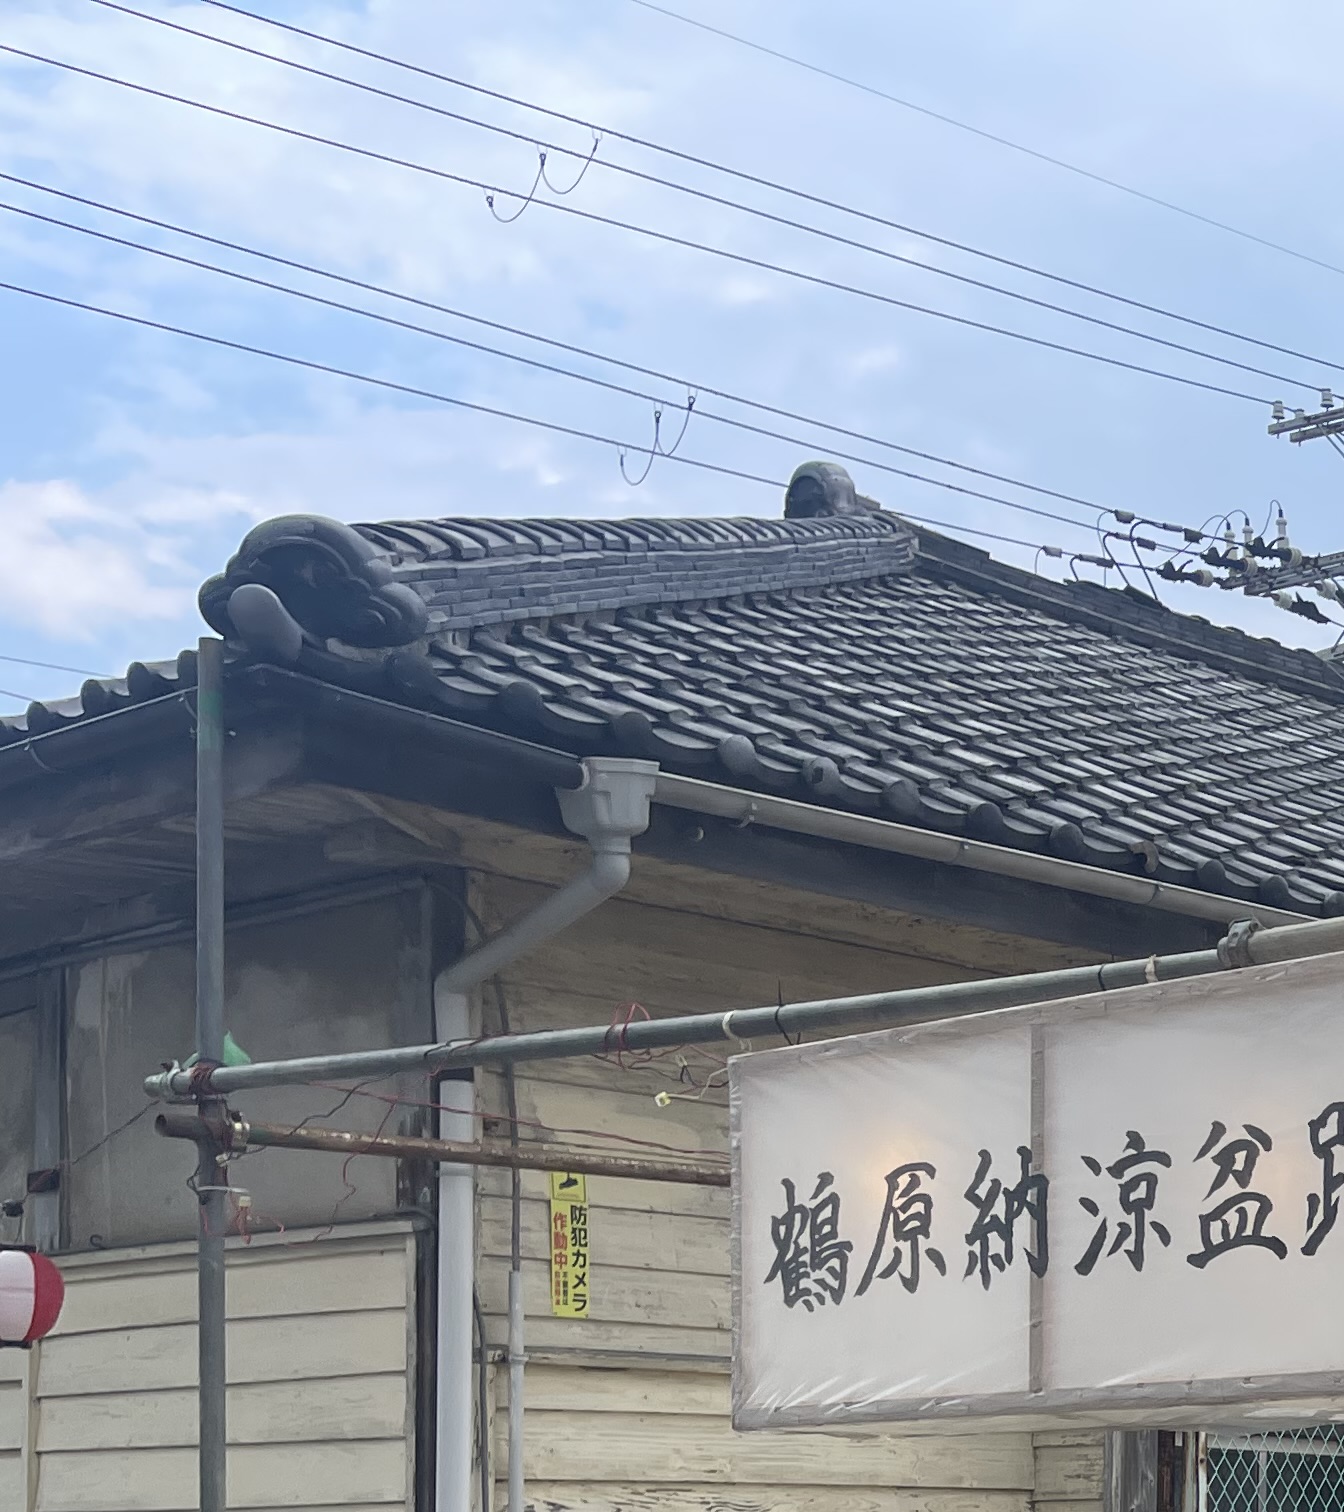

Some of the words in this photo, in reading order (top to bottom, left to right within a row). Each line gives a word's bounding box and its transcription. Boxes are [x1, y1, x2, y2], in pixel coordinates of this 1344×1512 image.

[553, 1211, 568, 1270] 作動中
[570, 1204, 588, 1312] 防犯カメラ
